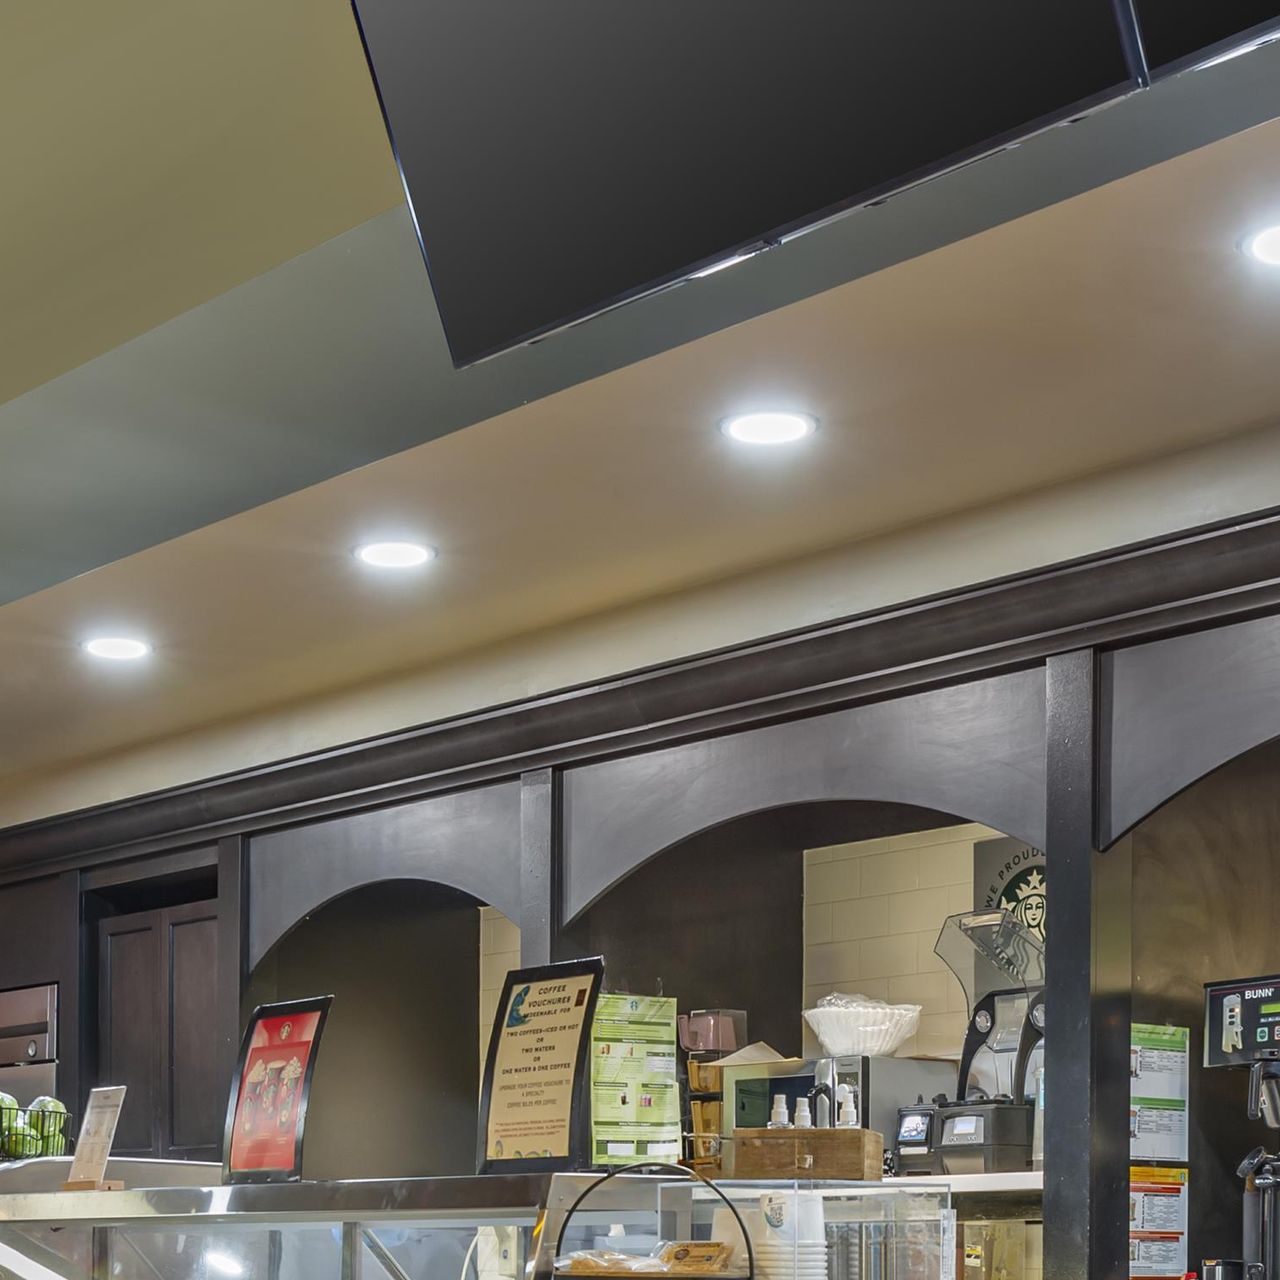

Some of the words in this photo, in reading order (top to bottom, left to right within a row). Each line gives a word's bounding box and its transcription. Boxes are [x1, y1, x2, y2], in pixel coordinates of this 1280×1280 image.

[984, 884, 999, 908] WE
[998, 846, 1046, 880] PROUD
[538, 984, 567, 996] COFFEE
[1244, 988, 1273, 1000] BUNN
[528, 995, 571, 1008] VOUCHURES
